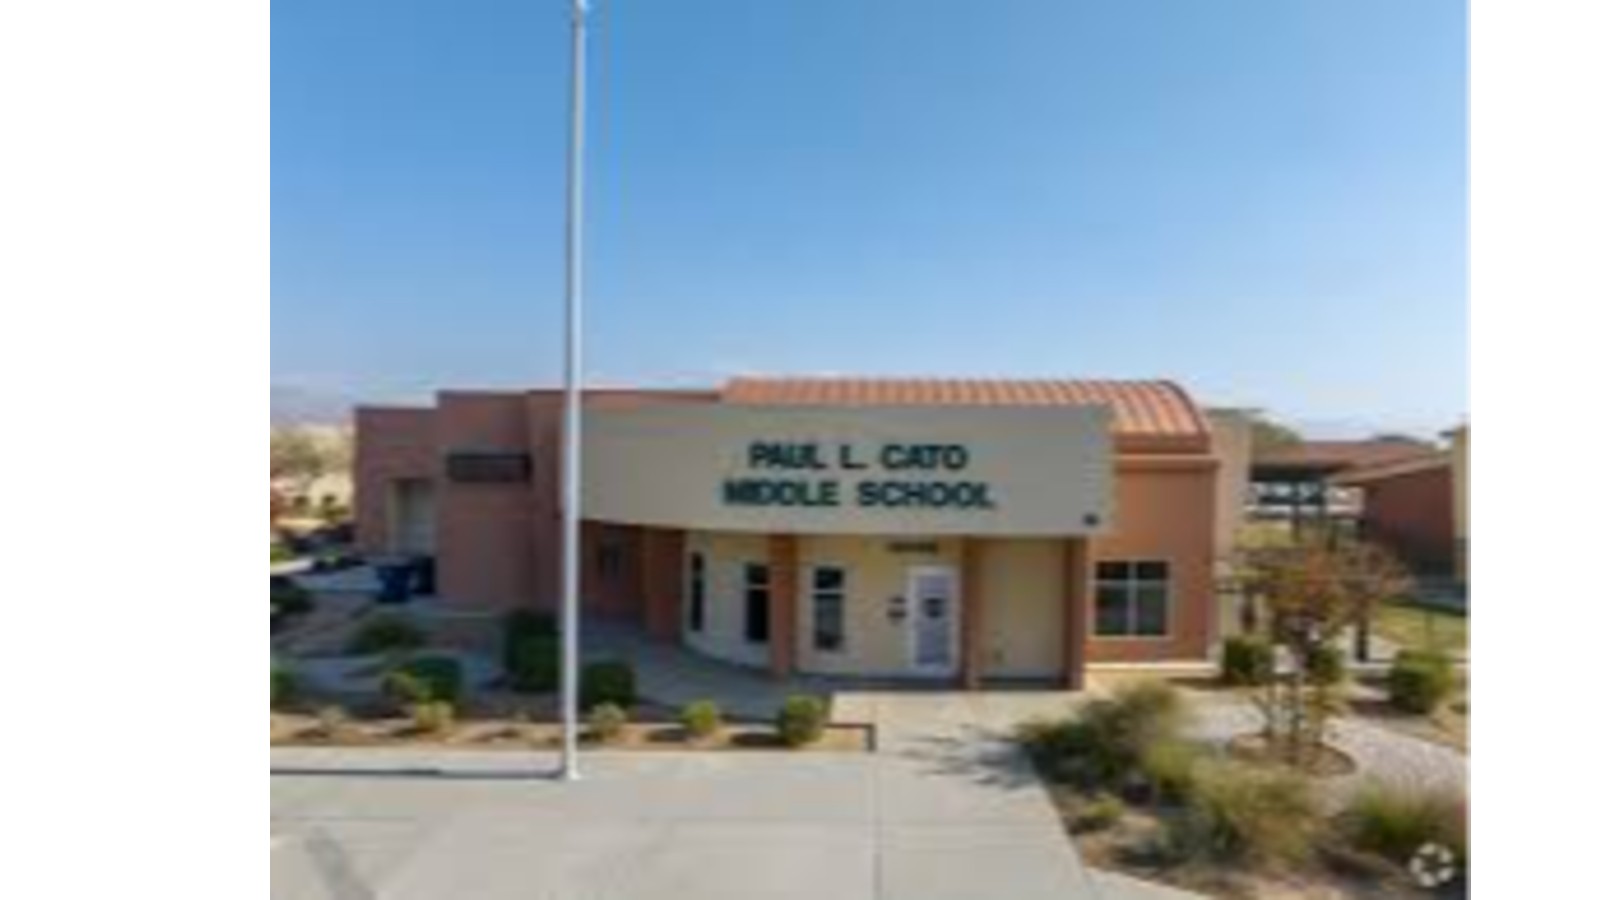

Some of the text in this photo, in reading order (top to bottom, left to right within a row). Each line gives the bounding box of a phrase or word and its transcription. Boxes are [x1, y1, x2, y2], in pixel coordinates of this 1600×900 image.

[748, 442, 828, 470] PAUL
[881, 443, 969, 470] CATO
[722, 480, 995, 509] MIDDLE SCHOOL
